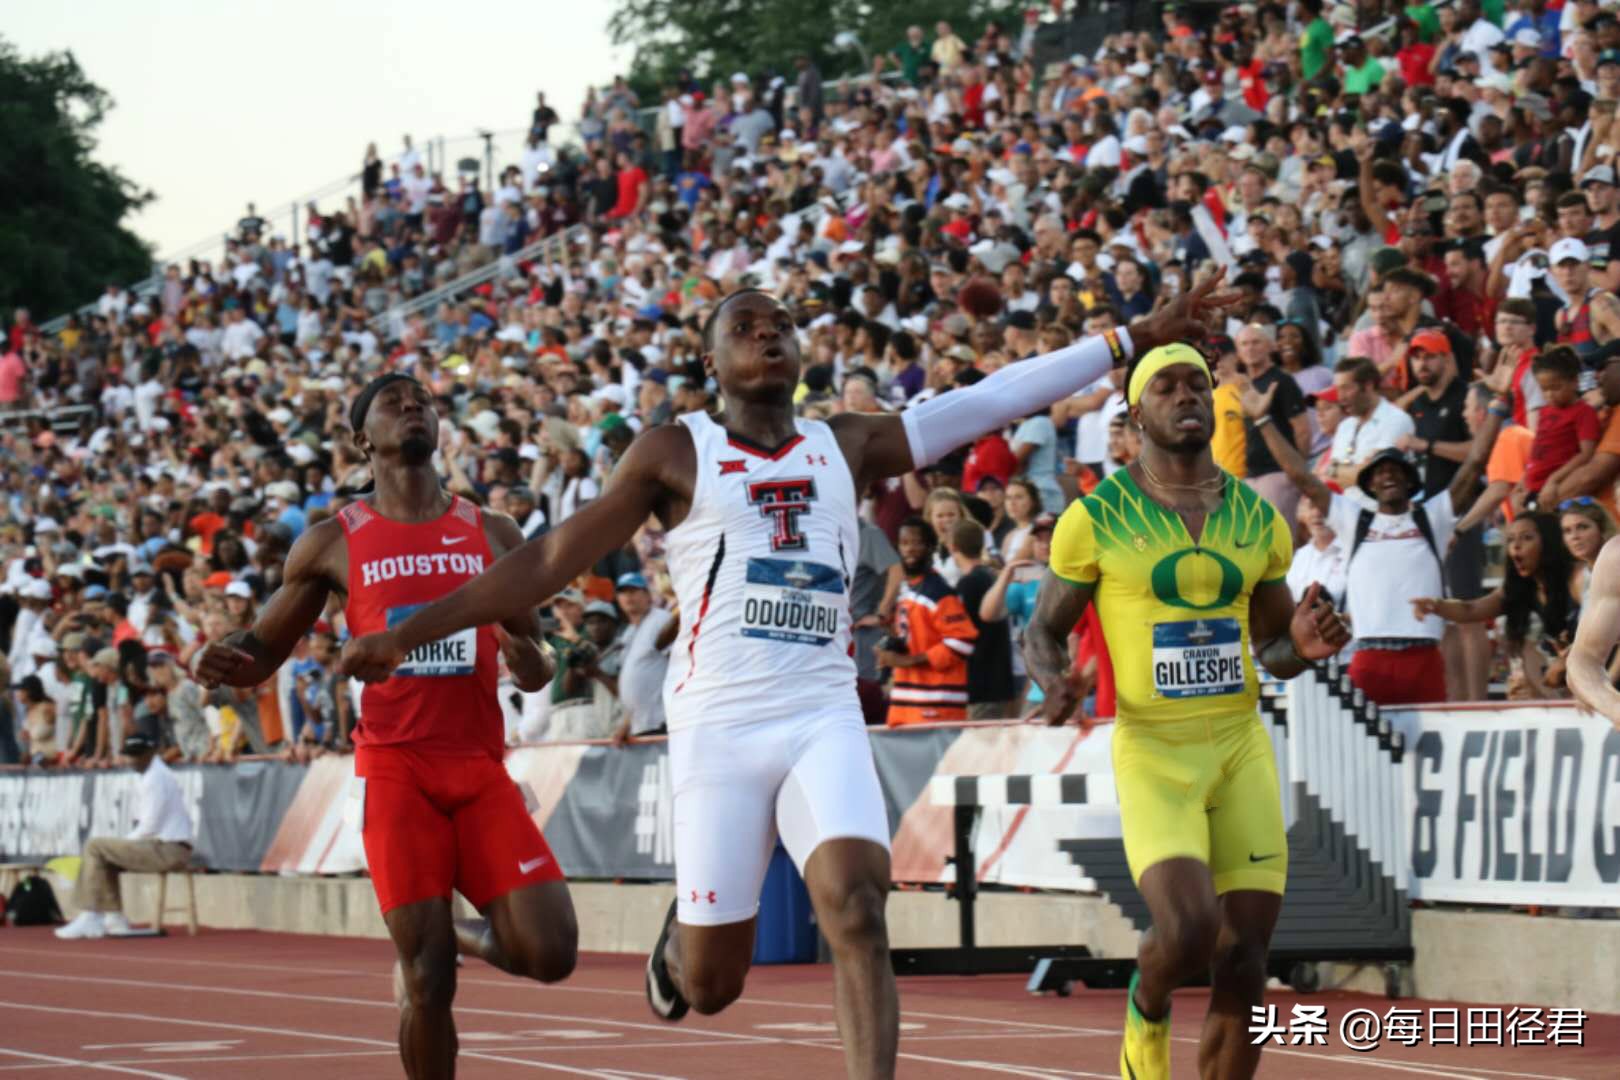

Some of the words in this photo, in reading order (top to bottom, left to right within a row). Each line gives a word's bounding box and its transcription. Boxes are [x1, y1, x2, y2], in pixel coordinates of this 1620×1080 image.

[362, 552, 484, 587] HOUSTON
[1151, 547, 1244, 610] O
[744, 597, 838, 635] ODUDURU
[1155, 655, 1243, 686] GILLESPIE
[1453, 727, 1584, 883] FIELD
